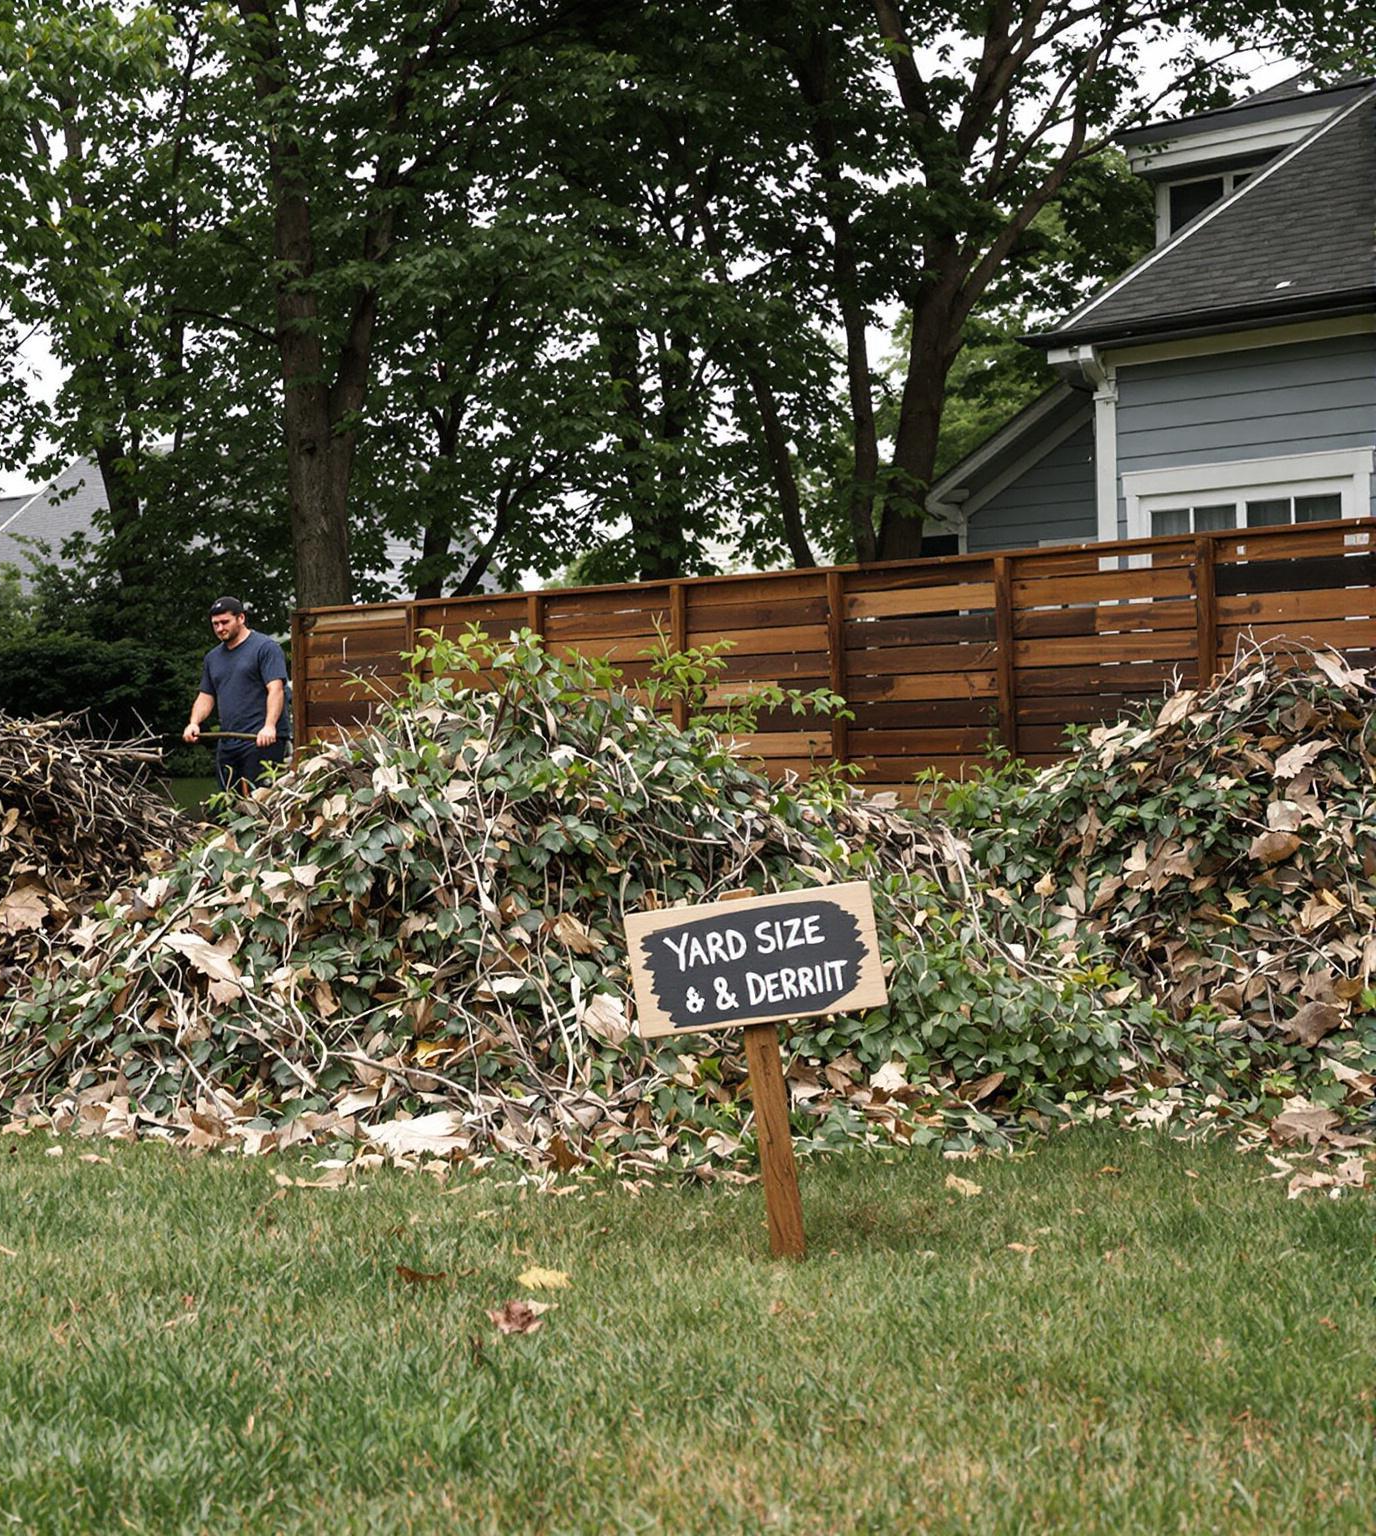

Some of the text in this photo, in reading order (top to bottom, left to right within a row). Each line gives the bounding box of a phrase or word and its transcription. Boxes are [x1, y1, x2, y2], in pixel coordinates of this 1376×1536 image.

[662, 914, 825, 972] YARD SIZE
[686, 986, 705, 1014] &
[713, 976, 740, 1011] &
